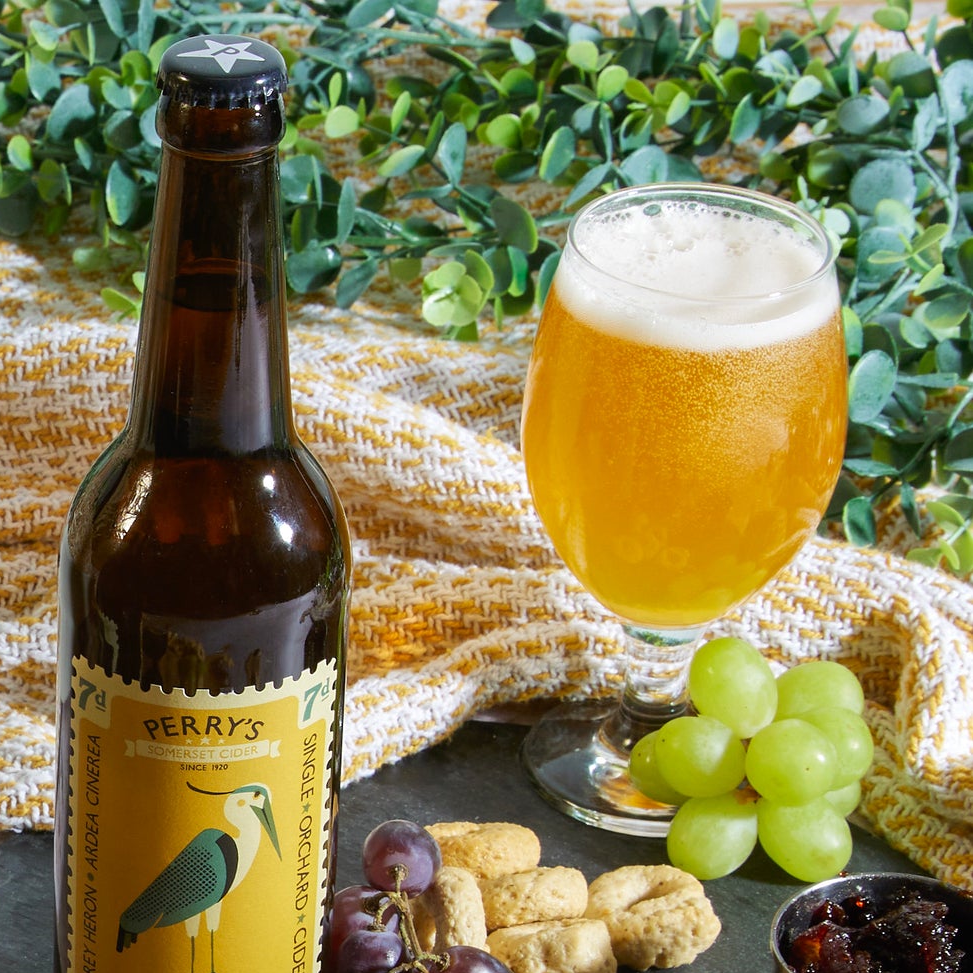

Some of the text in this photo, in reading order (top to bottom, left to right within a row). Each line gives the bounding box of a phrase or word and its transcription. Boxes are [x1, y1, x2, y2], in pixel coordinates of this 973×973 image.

[143, 715, 265, 741] PERRY'S
[303, 677, 330, 722] 7d
[86, 734, 101, 806] CINEREA
[147, 744, 259, 760] SOMERSET CIDER
[180, 763, 229, 772] SINCE 1920
[300, 733, 318, 802] SINGLE
[85, 812, 100, 871] ARDEA
[295, 815, 313, 911] ORCHARD
[83, 884, 98, 943] HERON
